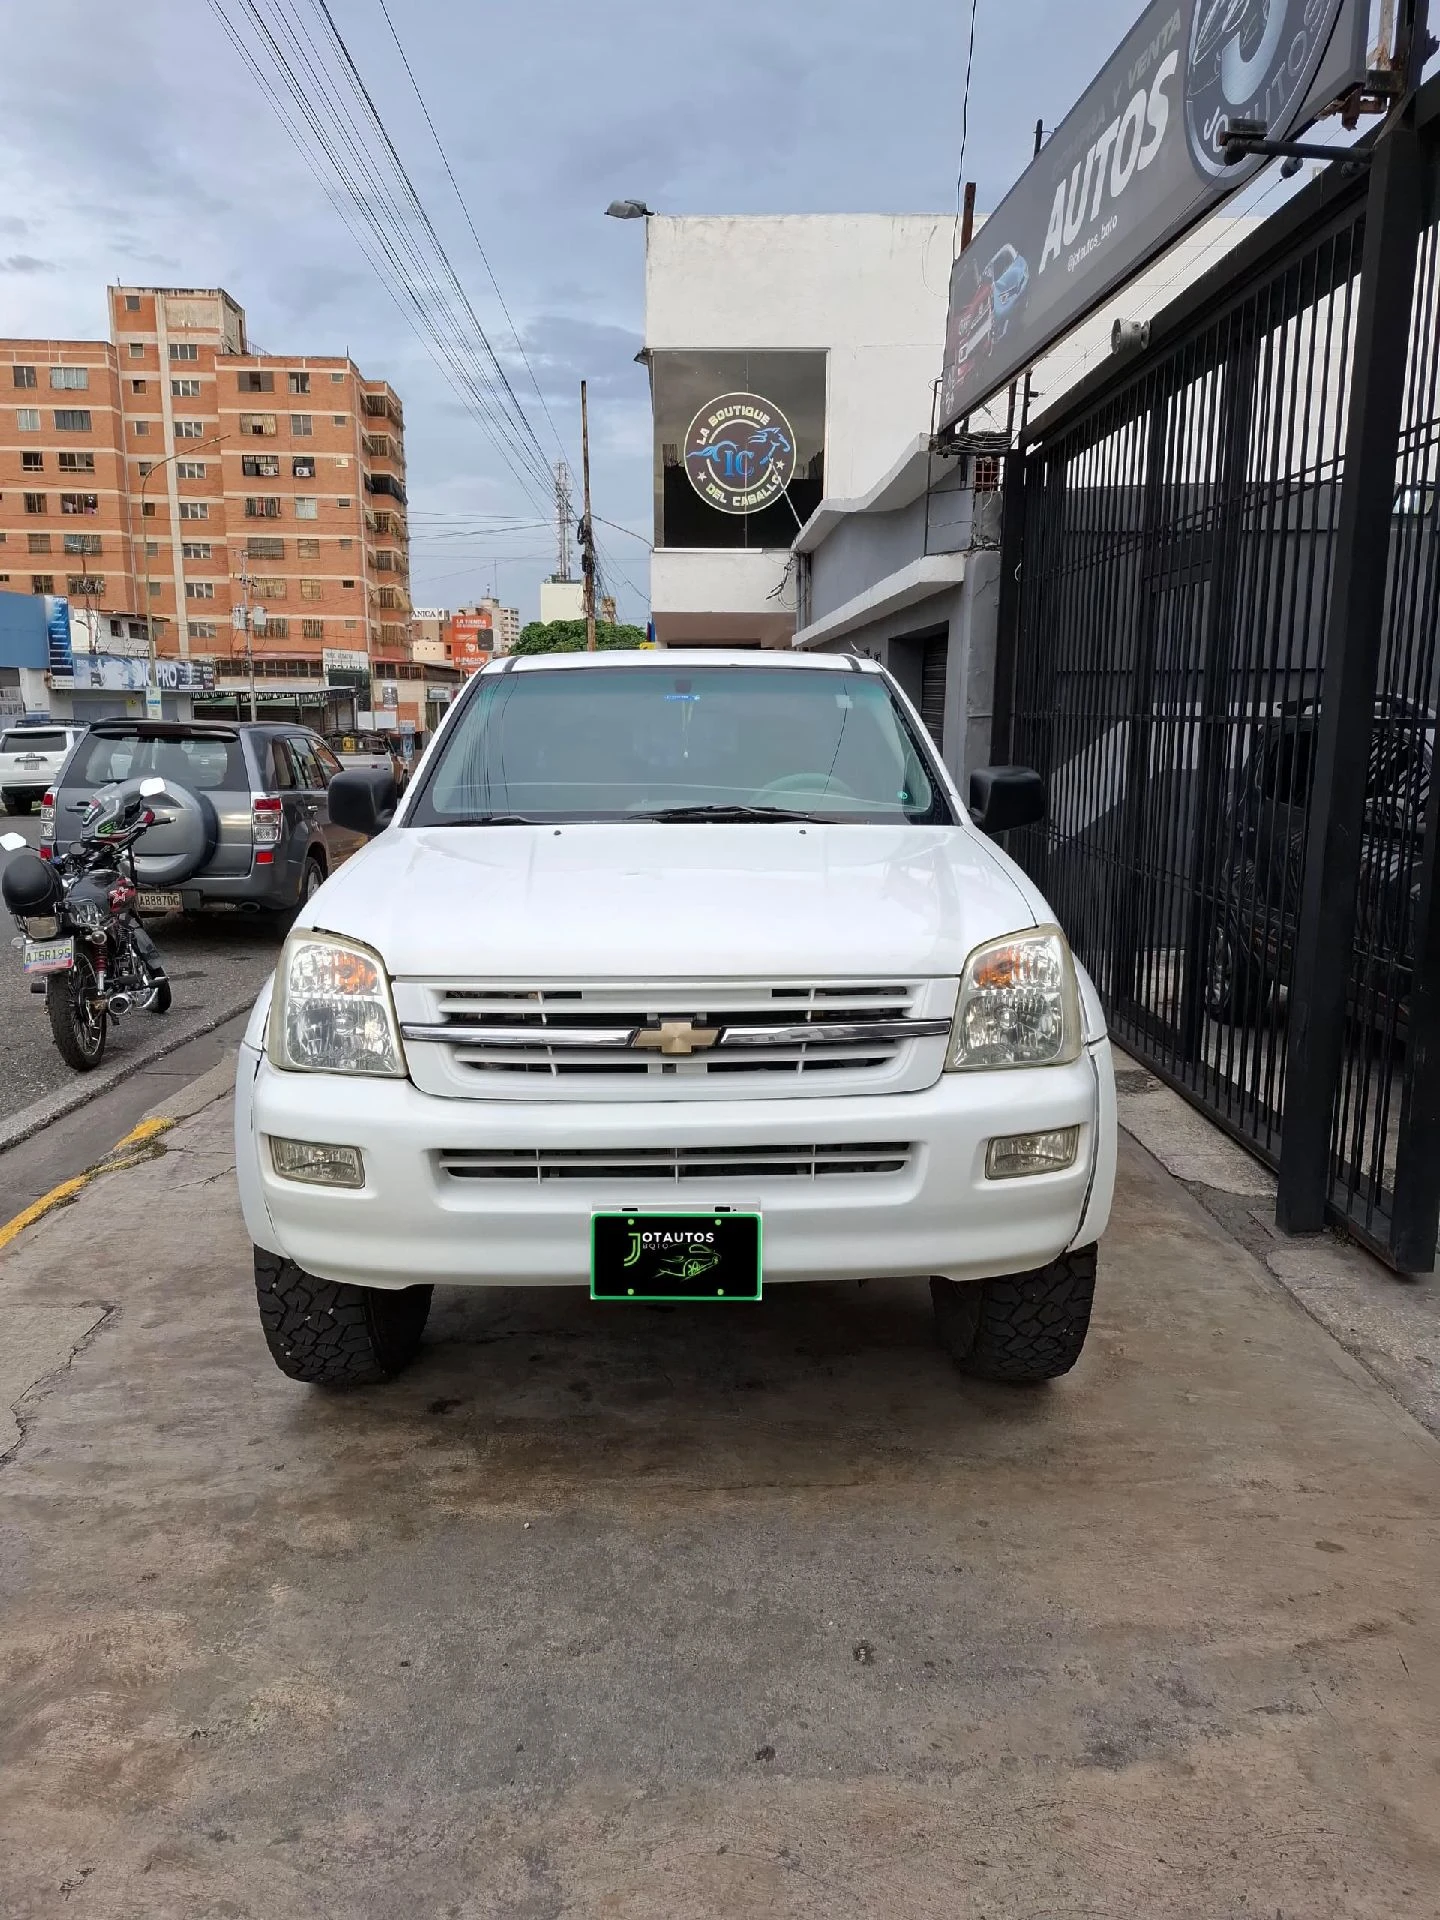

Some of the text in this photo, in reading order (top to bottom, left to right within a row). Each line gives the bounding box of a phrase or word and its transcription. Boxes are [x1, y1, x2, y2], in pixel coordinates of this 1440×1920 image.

[1128, 8, 1182, 90] VENTA
[1038, 50, 1179, 275] AUTOS
[696, 406, 769, 446] LA BOUTIQUE
[723, 450, 755, 478] IC
[705, 475, 782, 507] DEL CABALLO
